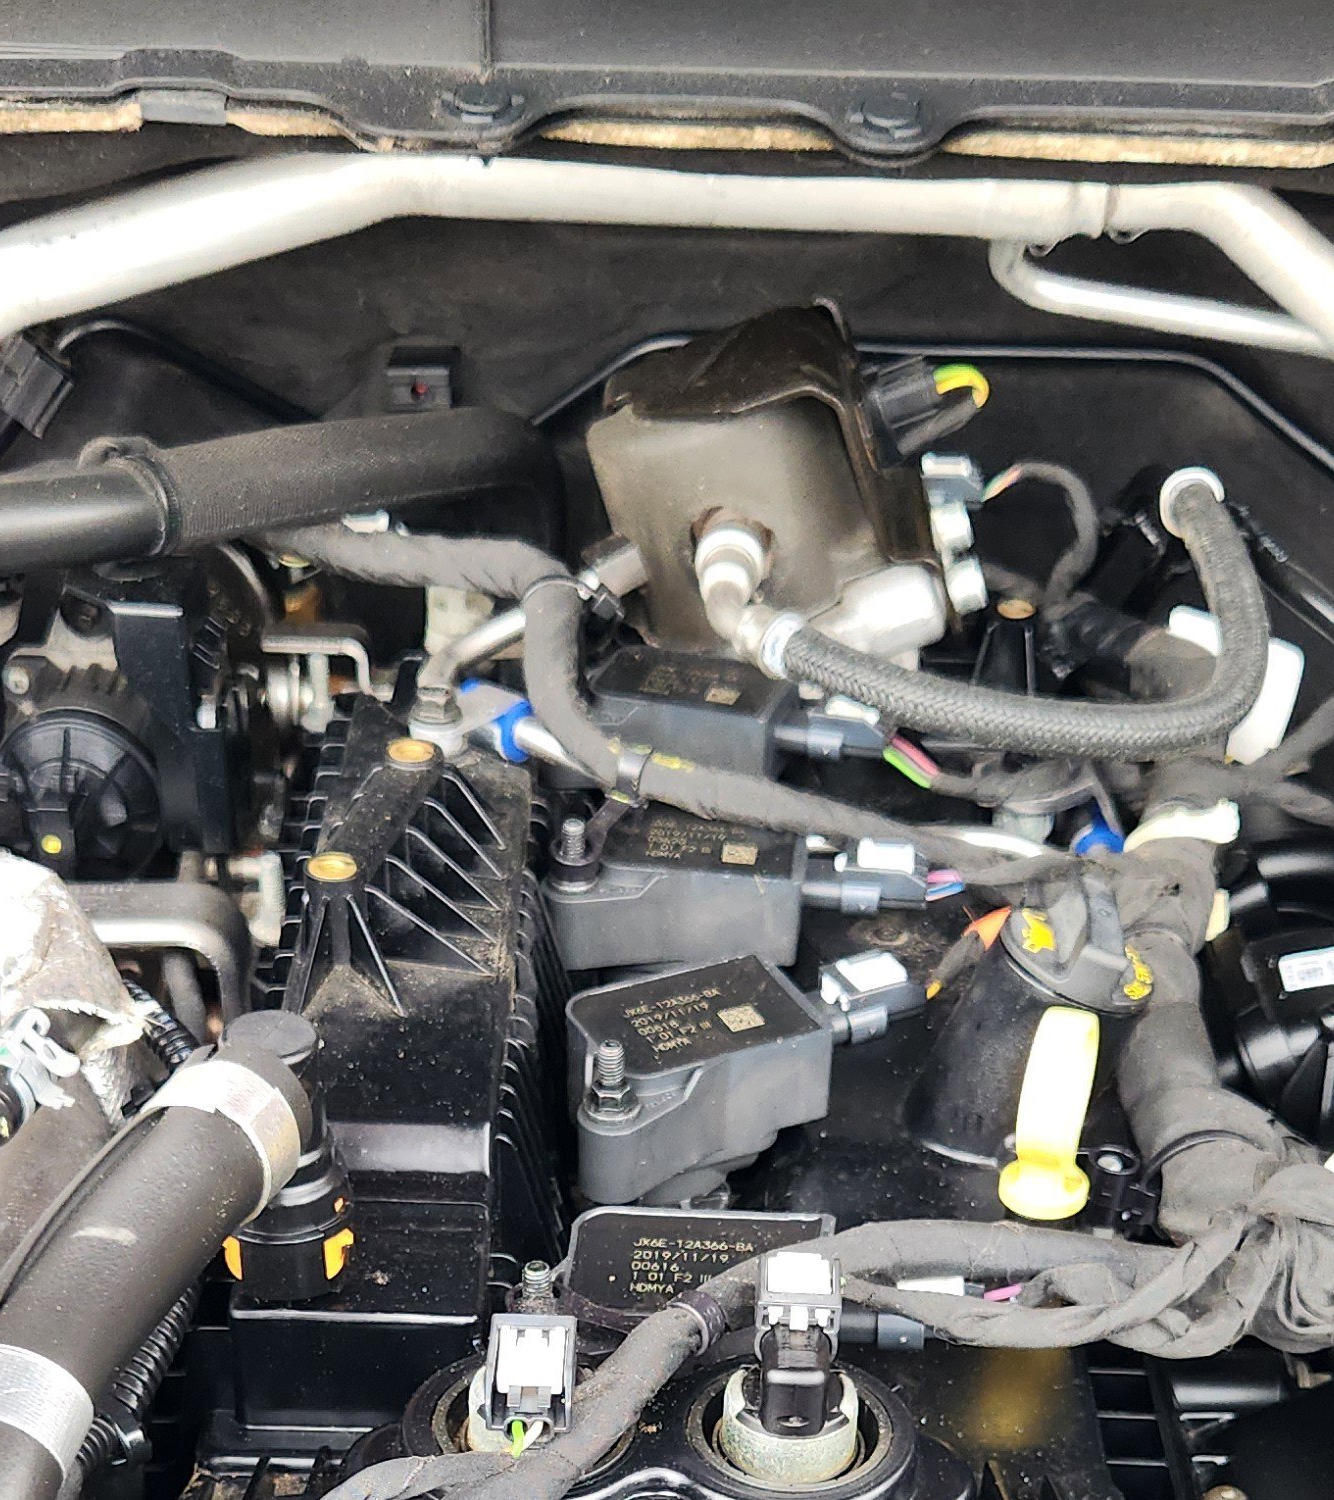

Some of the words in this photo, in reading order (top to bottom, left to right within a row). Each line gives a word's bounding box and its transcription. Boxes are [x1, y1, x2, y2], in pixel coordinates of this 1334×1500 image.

[633, 1237, 754, 1252] JX6E-12A366-BA
[633, 1250, 729, 1264] 2019/11/19
[631, 1261, 680, 1272] 00616
[648, 1272, 664, 1281] 01
[673, 1273, 693, 1283] F2
[630, 1282, 675, 1293] HDMYA
